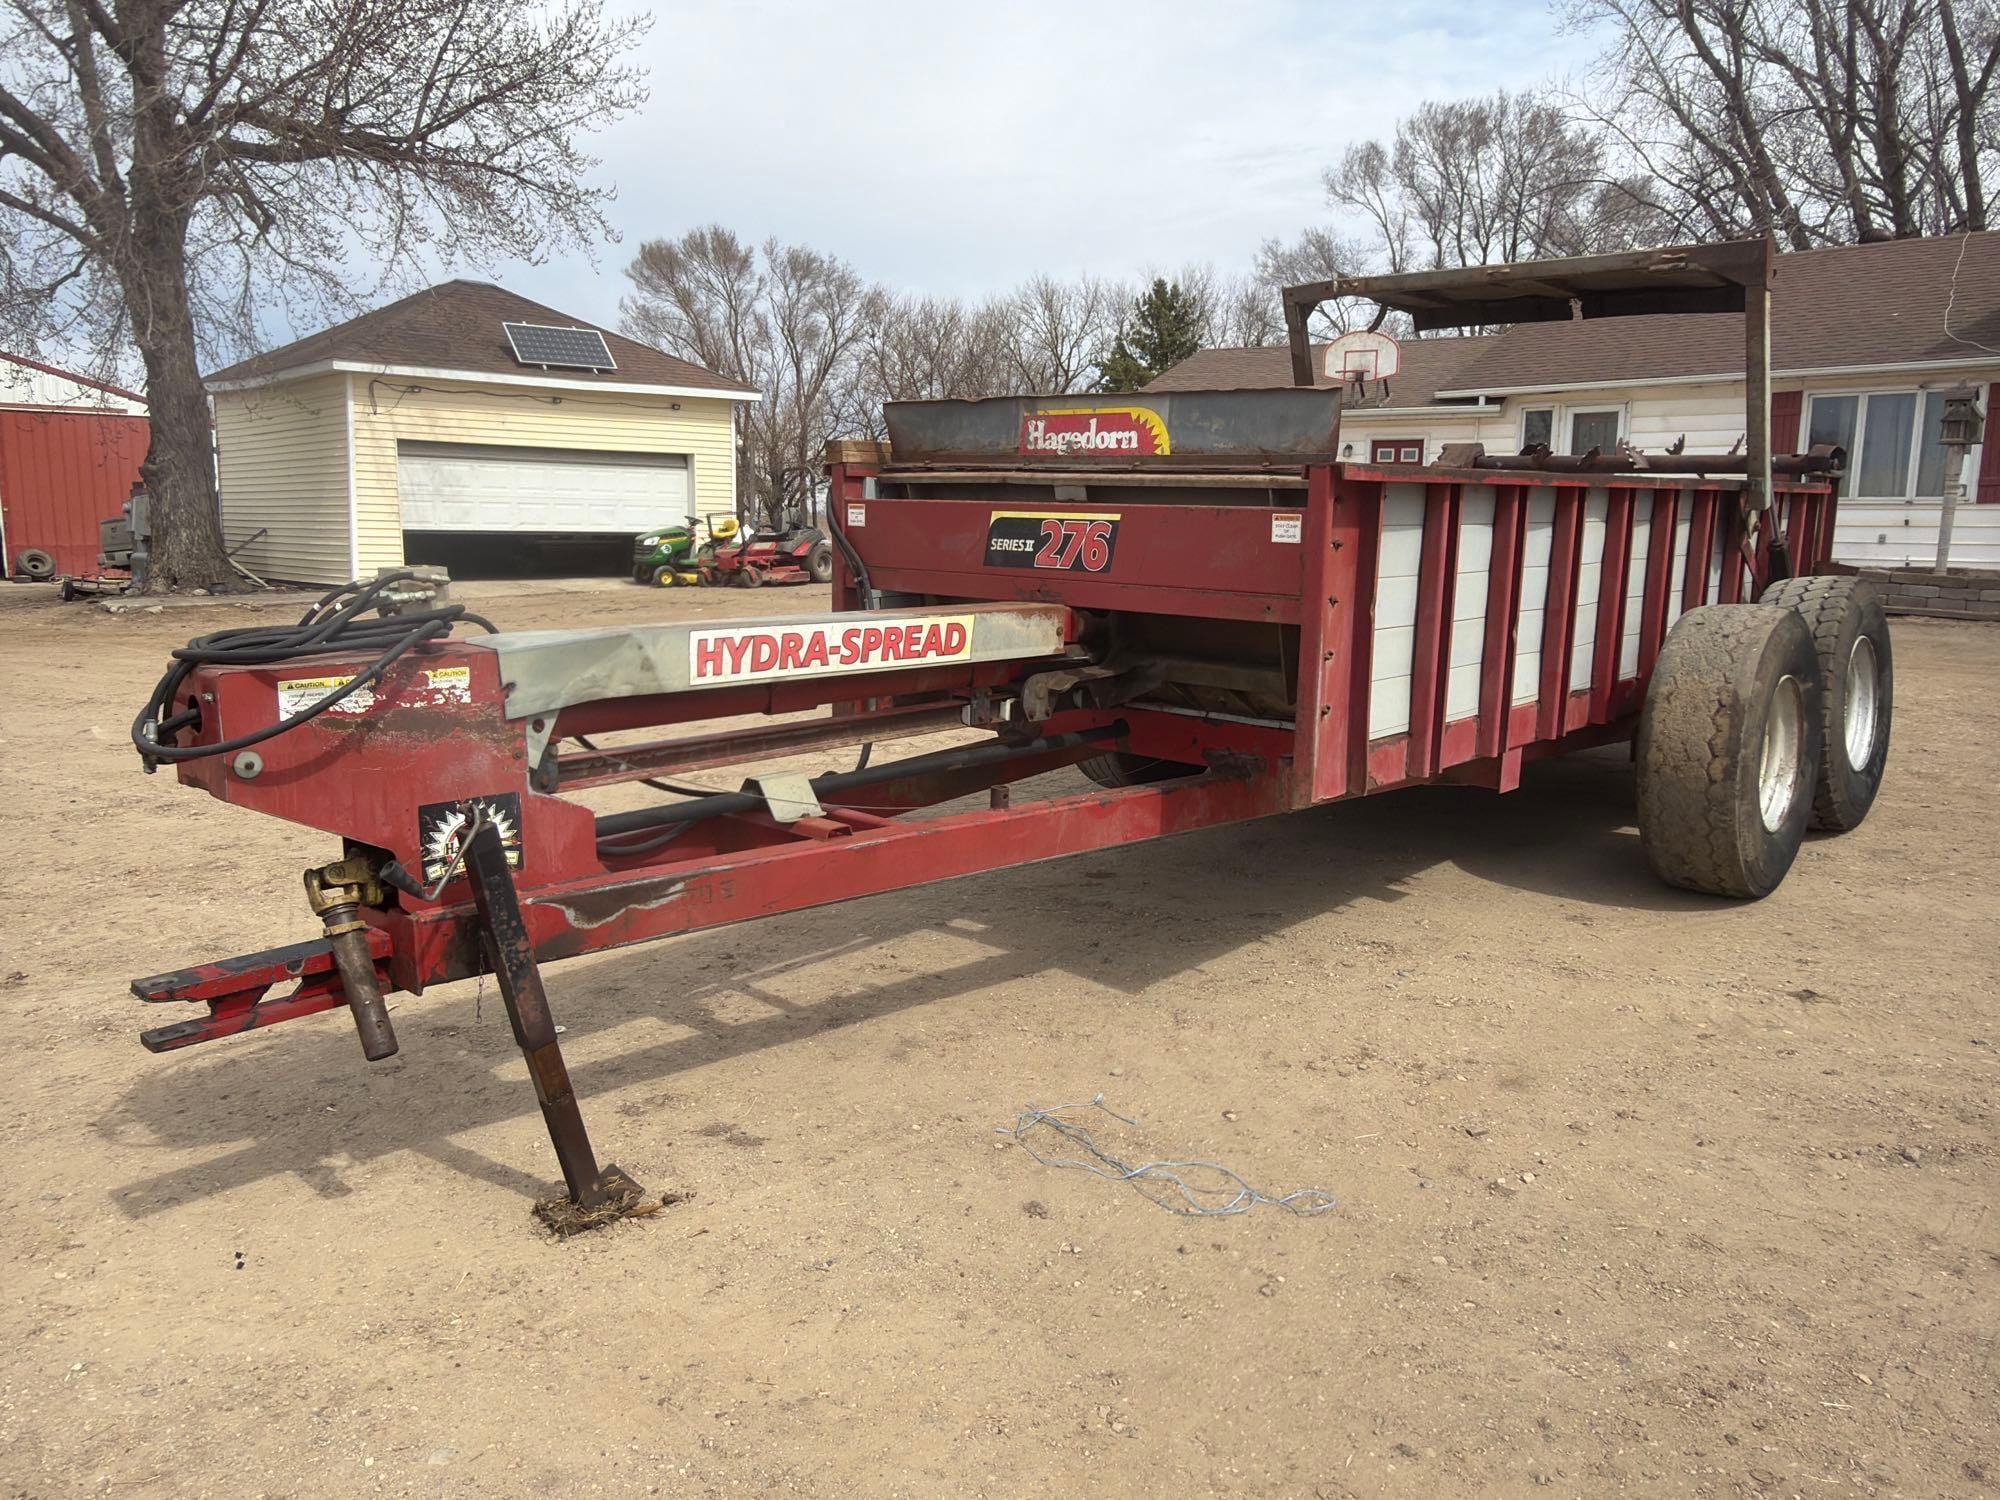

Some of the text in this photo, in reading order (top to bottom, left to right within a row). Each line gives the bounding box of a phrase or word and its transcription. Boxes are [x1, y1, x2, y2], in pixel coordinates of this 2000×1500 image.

[1026, 417, 1139, 455] Hagedorn
[990, 538, 1025, 552] SERIES
[1034, 518, 1113, 572] 276
[696, 622, 967, 678] HYDRA-SPREAD
[294, 681, 326, 689] CAUTION
